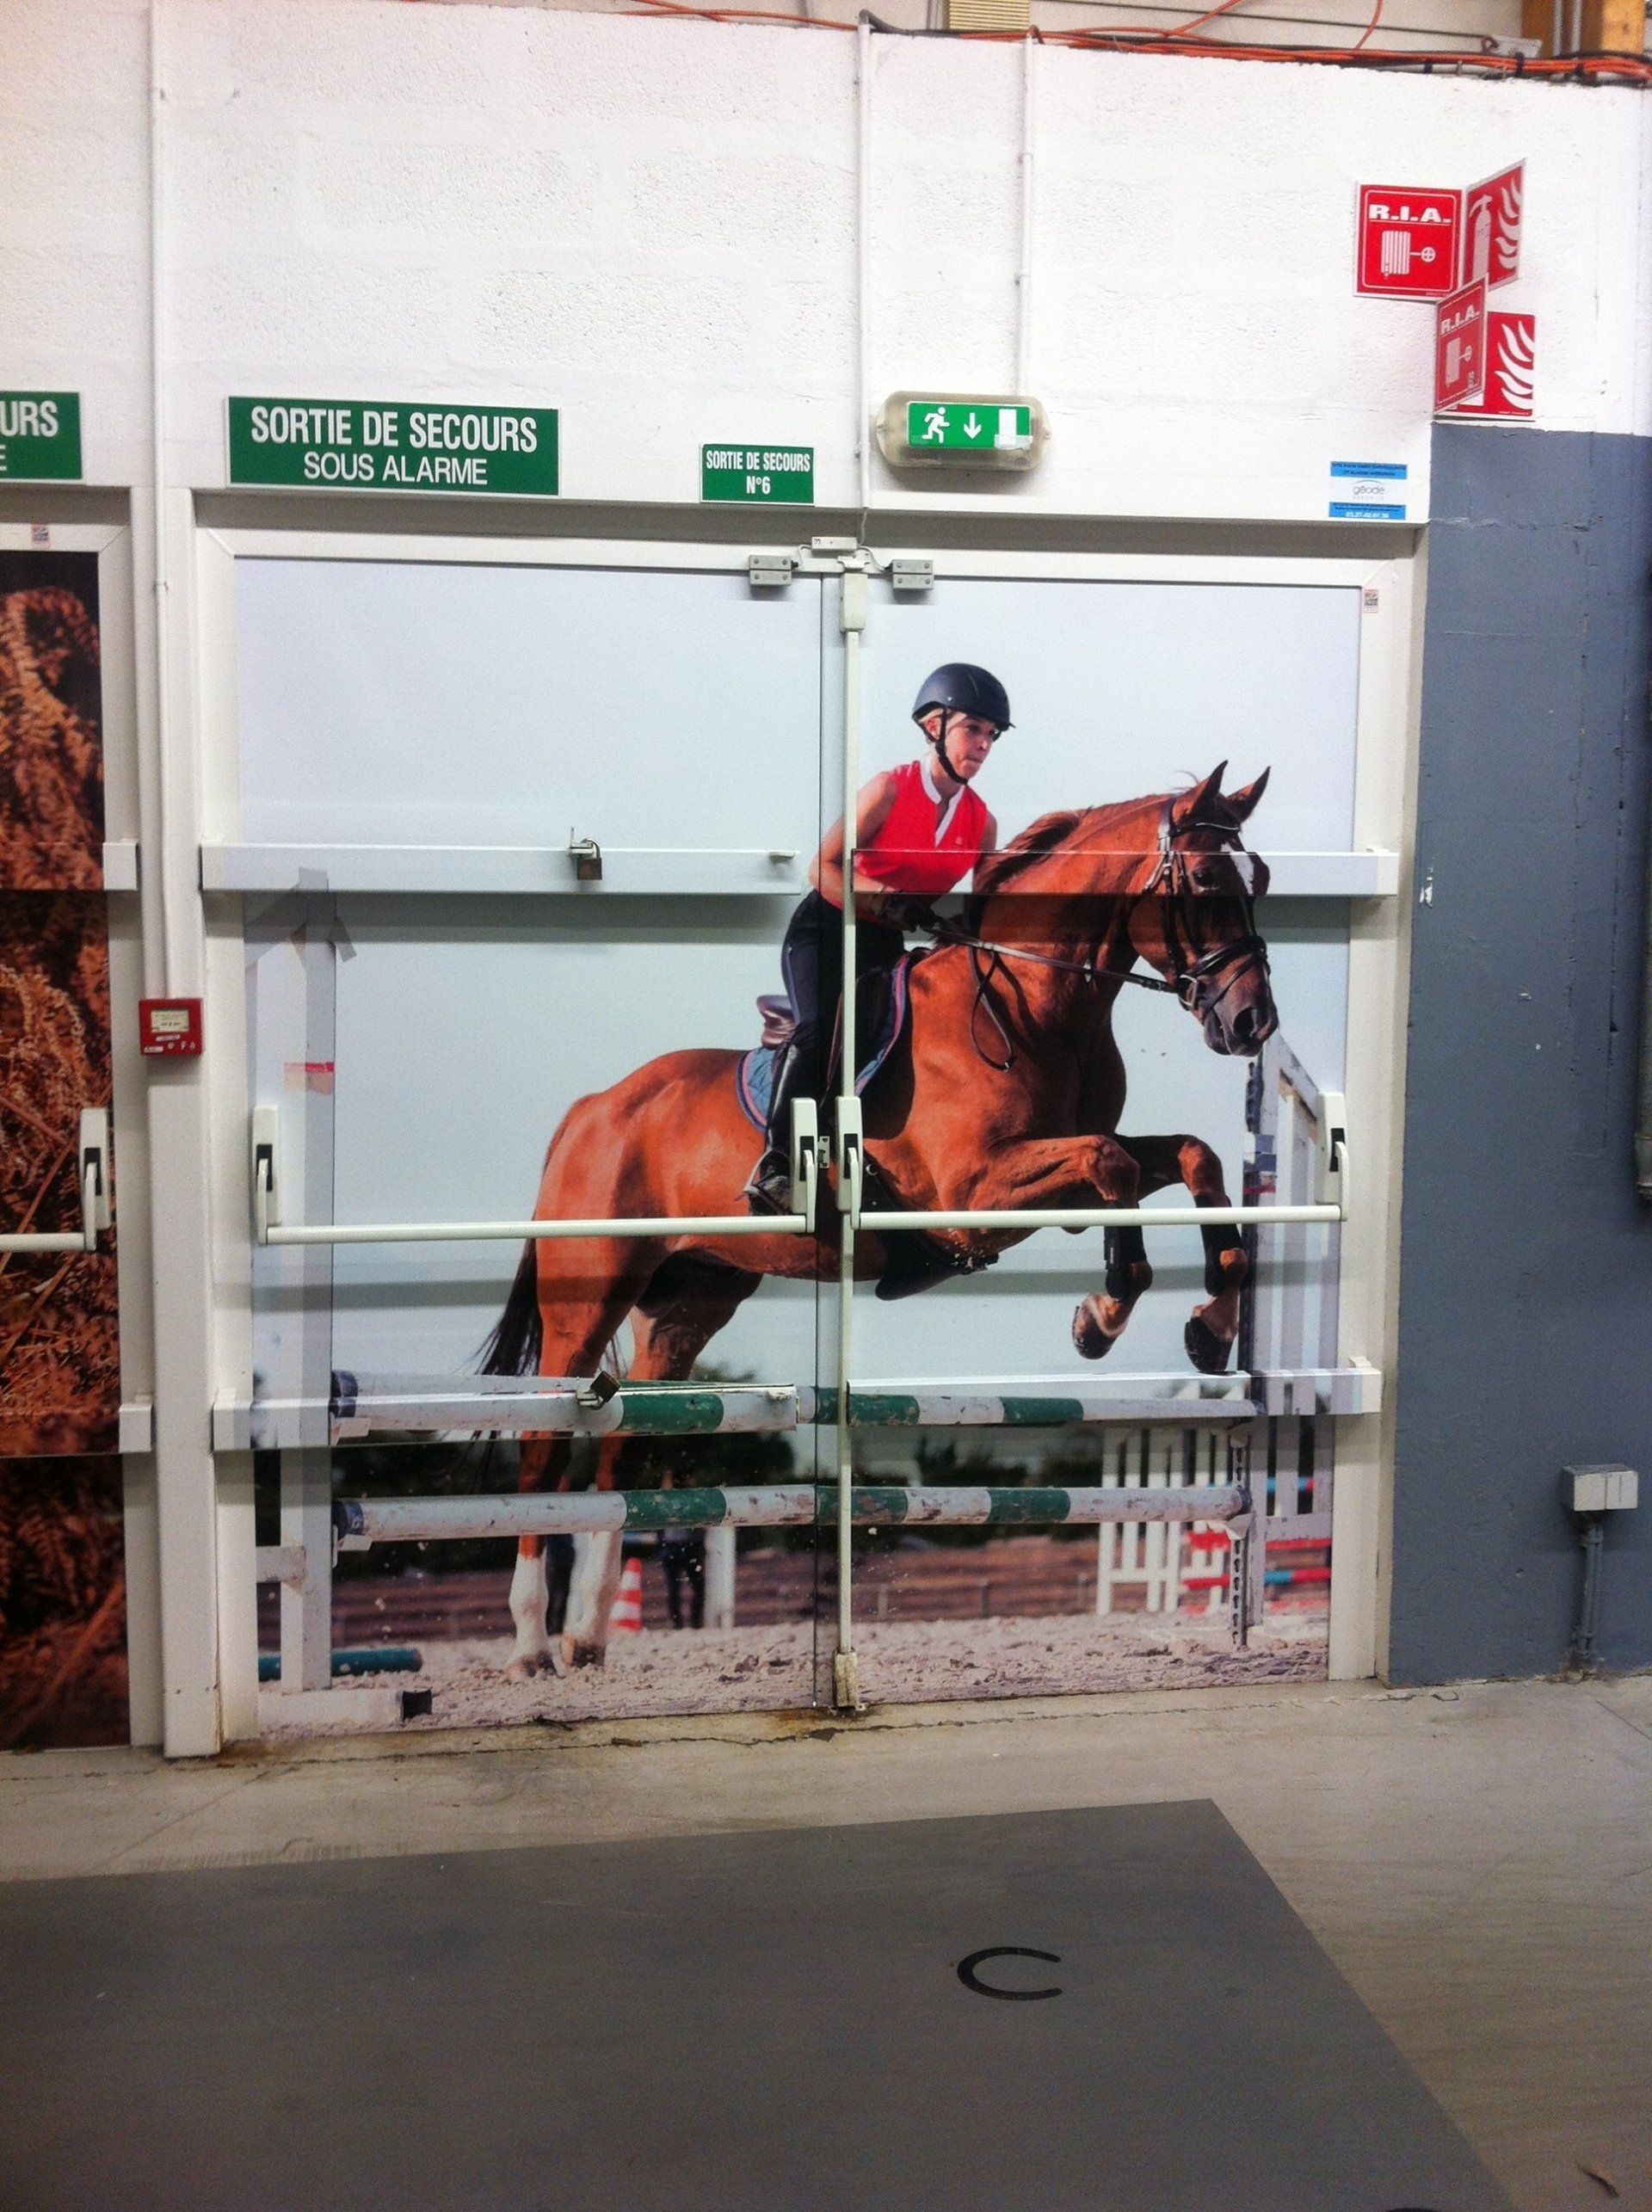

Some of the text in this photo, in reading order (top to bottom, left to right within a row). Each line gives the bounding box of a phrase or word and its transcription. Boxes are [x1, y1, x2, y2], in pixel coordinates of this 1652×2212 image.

[1368, 203, 1452, 224] R.I.A.
[1440, 304, 1480, 335] R.I.A.
[250, 405, 538, 453] SORTIE DE SECOURS
[303, 452, 487, 485] SOUS ALARME
[706, 450, 811, 472] SORTIE DE SECOURS
[746, 476, 771, 495] N°6
